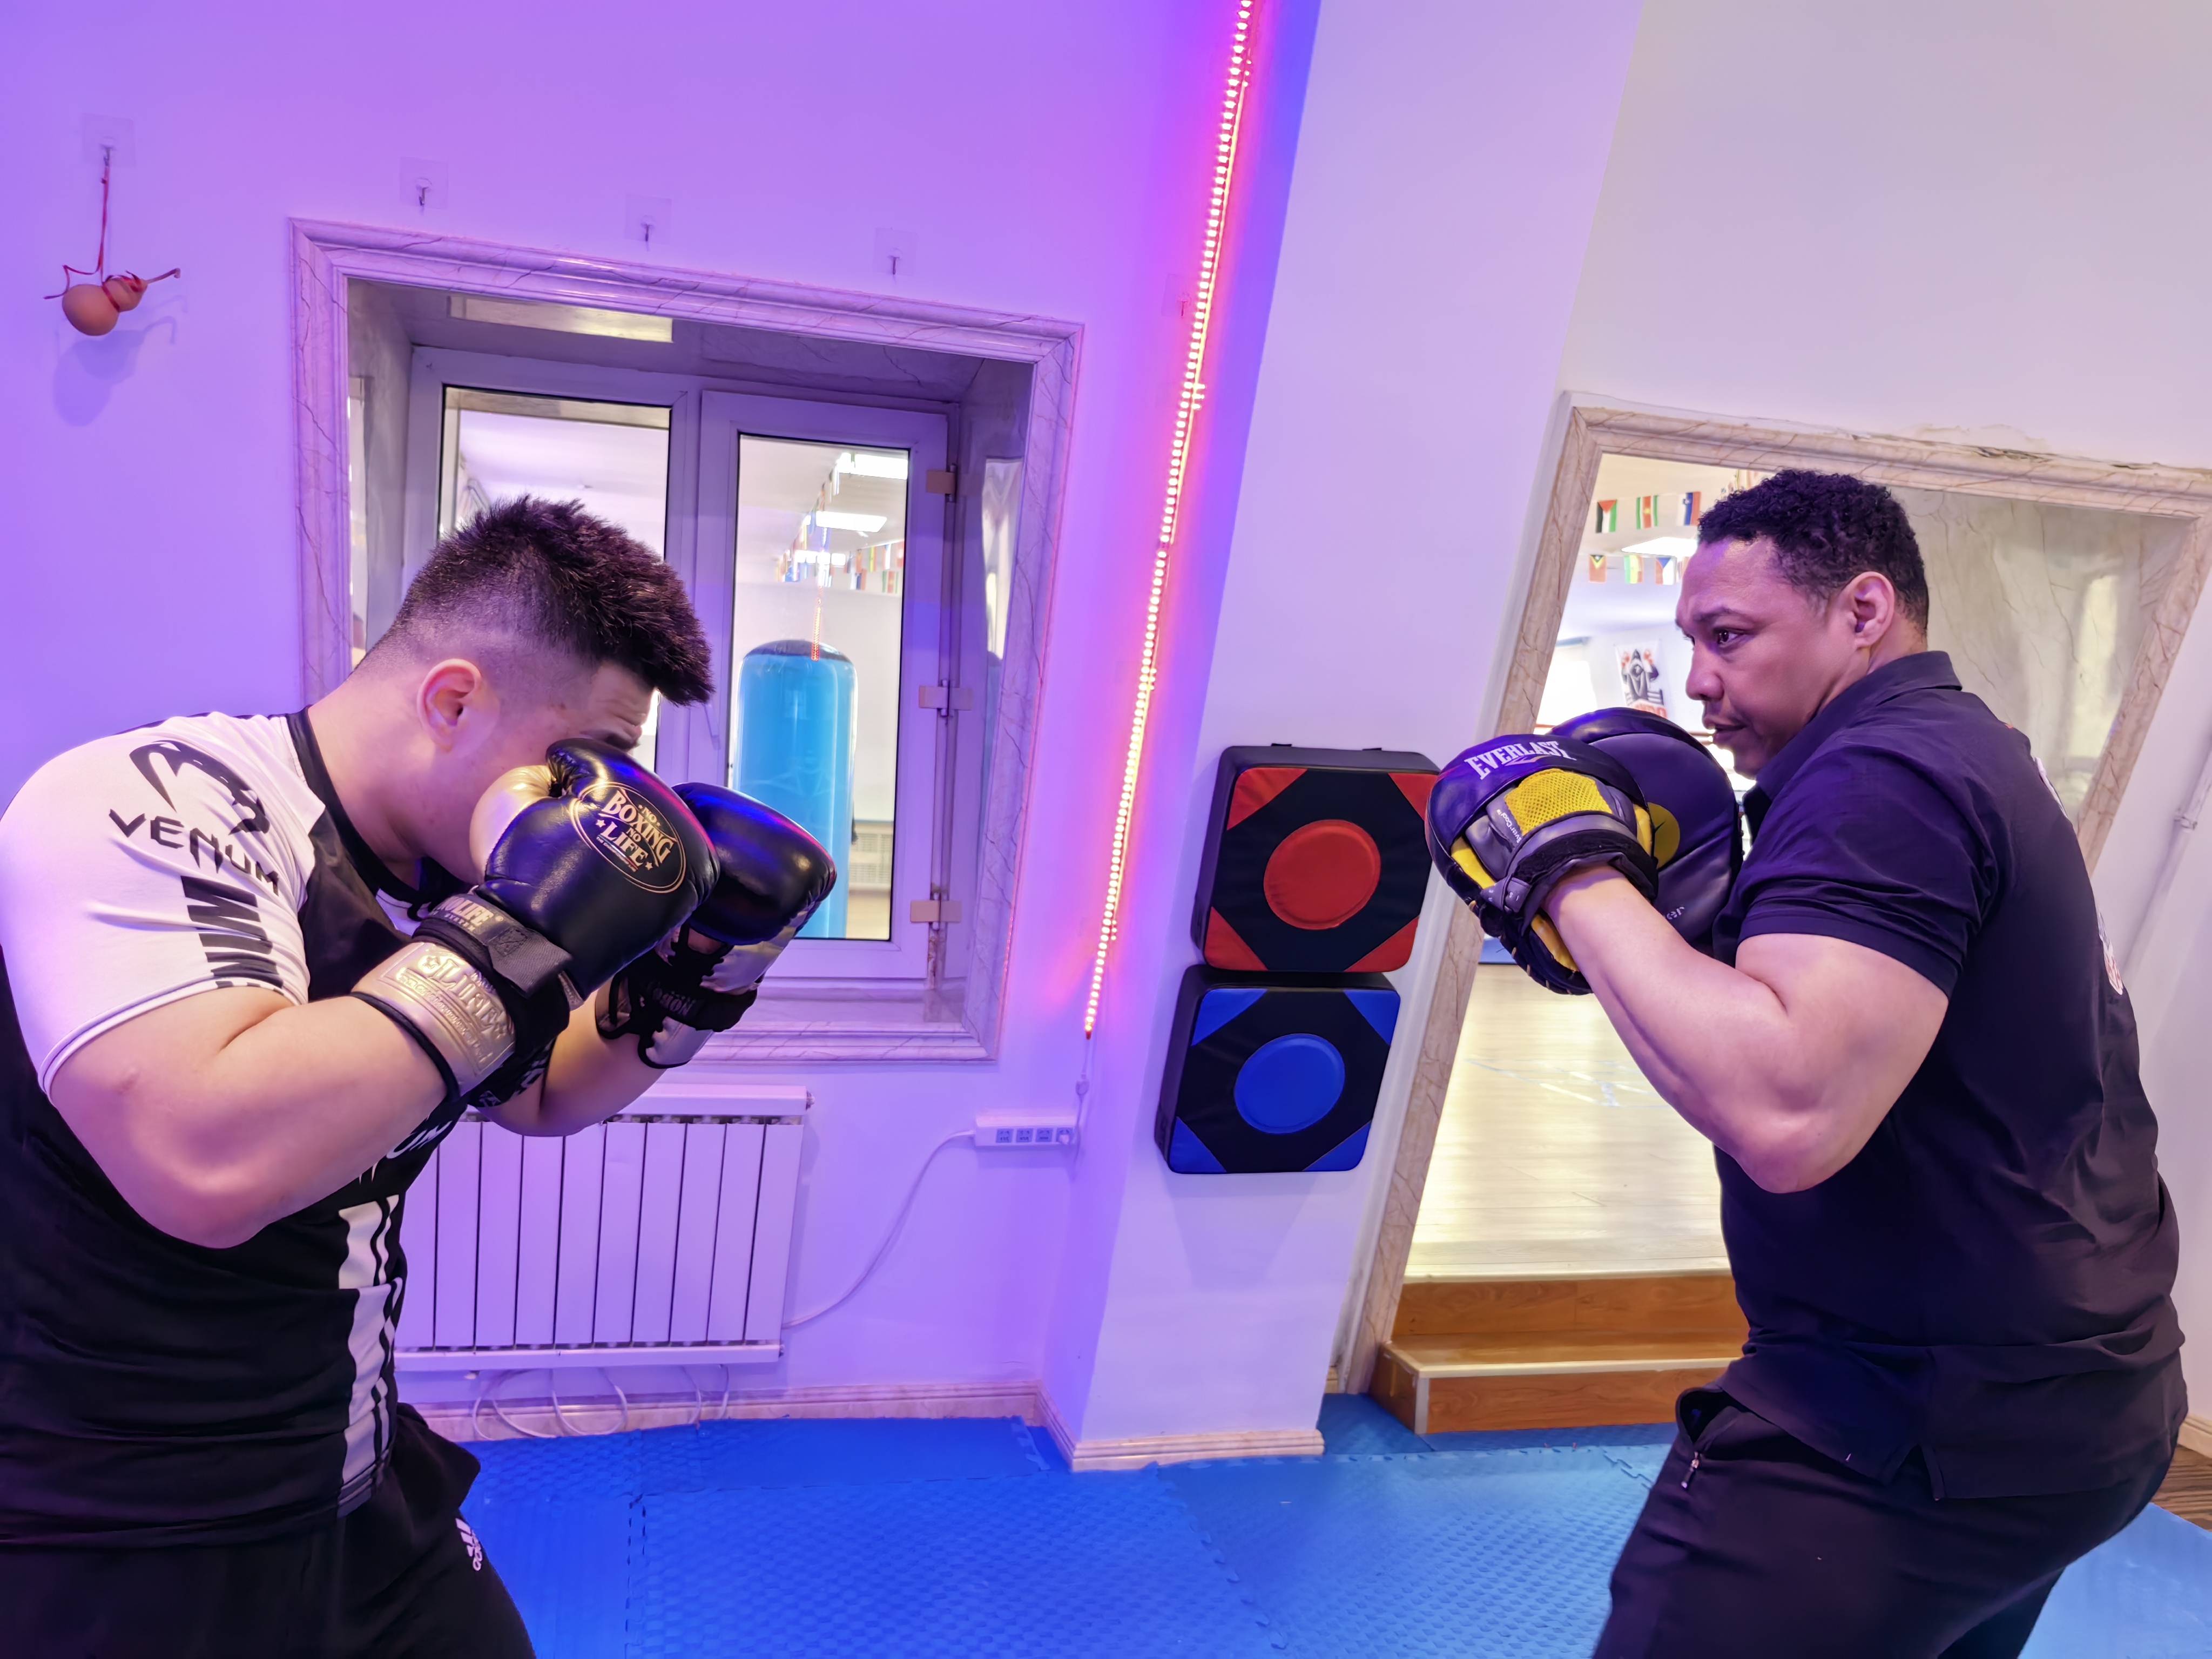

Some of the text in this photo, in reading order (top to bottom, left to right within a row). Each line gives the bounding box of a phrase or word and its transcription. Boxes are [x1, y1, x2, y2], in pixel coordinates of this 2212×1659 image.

[1464, 741, 1577, 780] EVERLAST
[602, 790, 674, 863] BOXING
[626, 827, 642, 842] NO
[642, 807, 657, 822] NO
[109, 809, 279, 896] VENUM
[601, 821, 648, 866] LIFE
